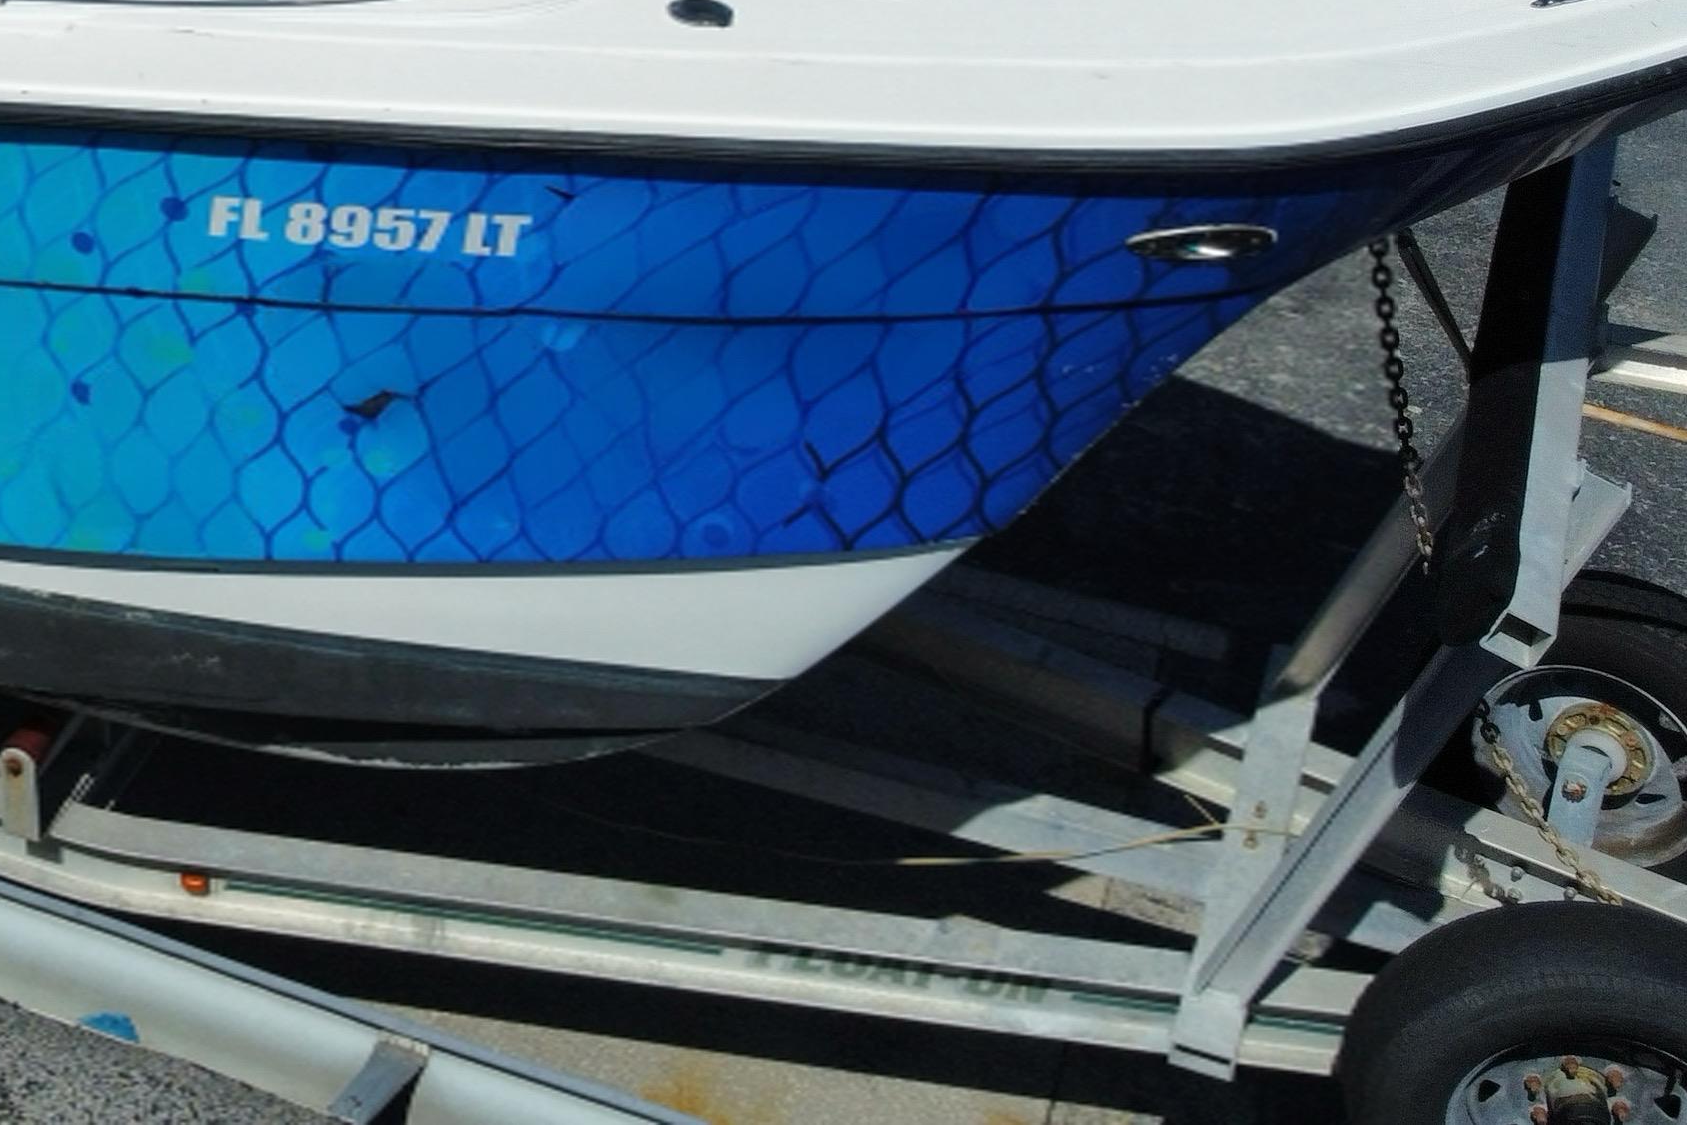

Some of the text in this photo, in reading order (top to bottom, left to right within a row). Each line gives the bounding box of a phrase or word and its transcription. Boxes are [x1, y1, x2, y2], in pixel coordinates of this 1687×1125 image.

[208, 195, 533, 256] FL 8957 LT
